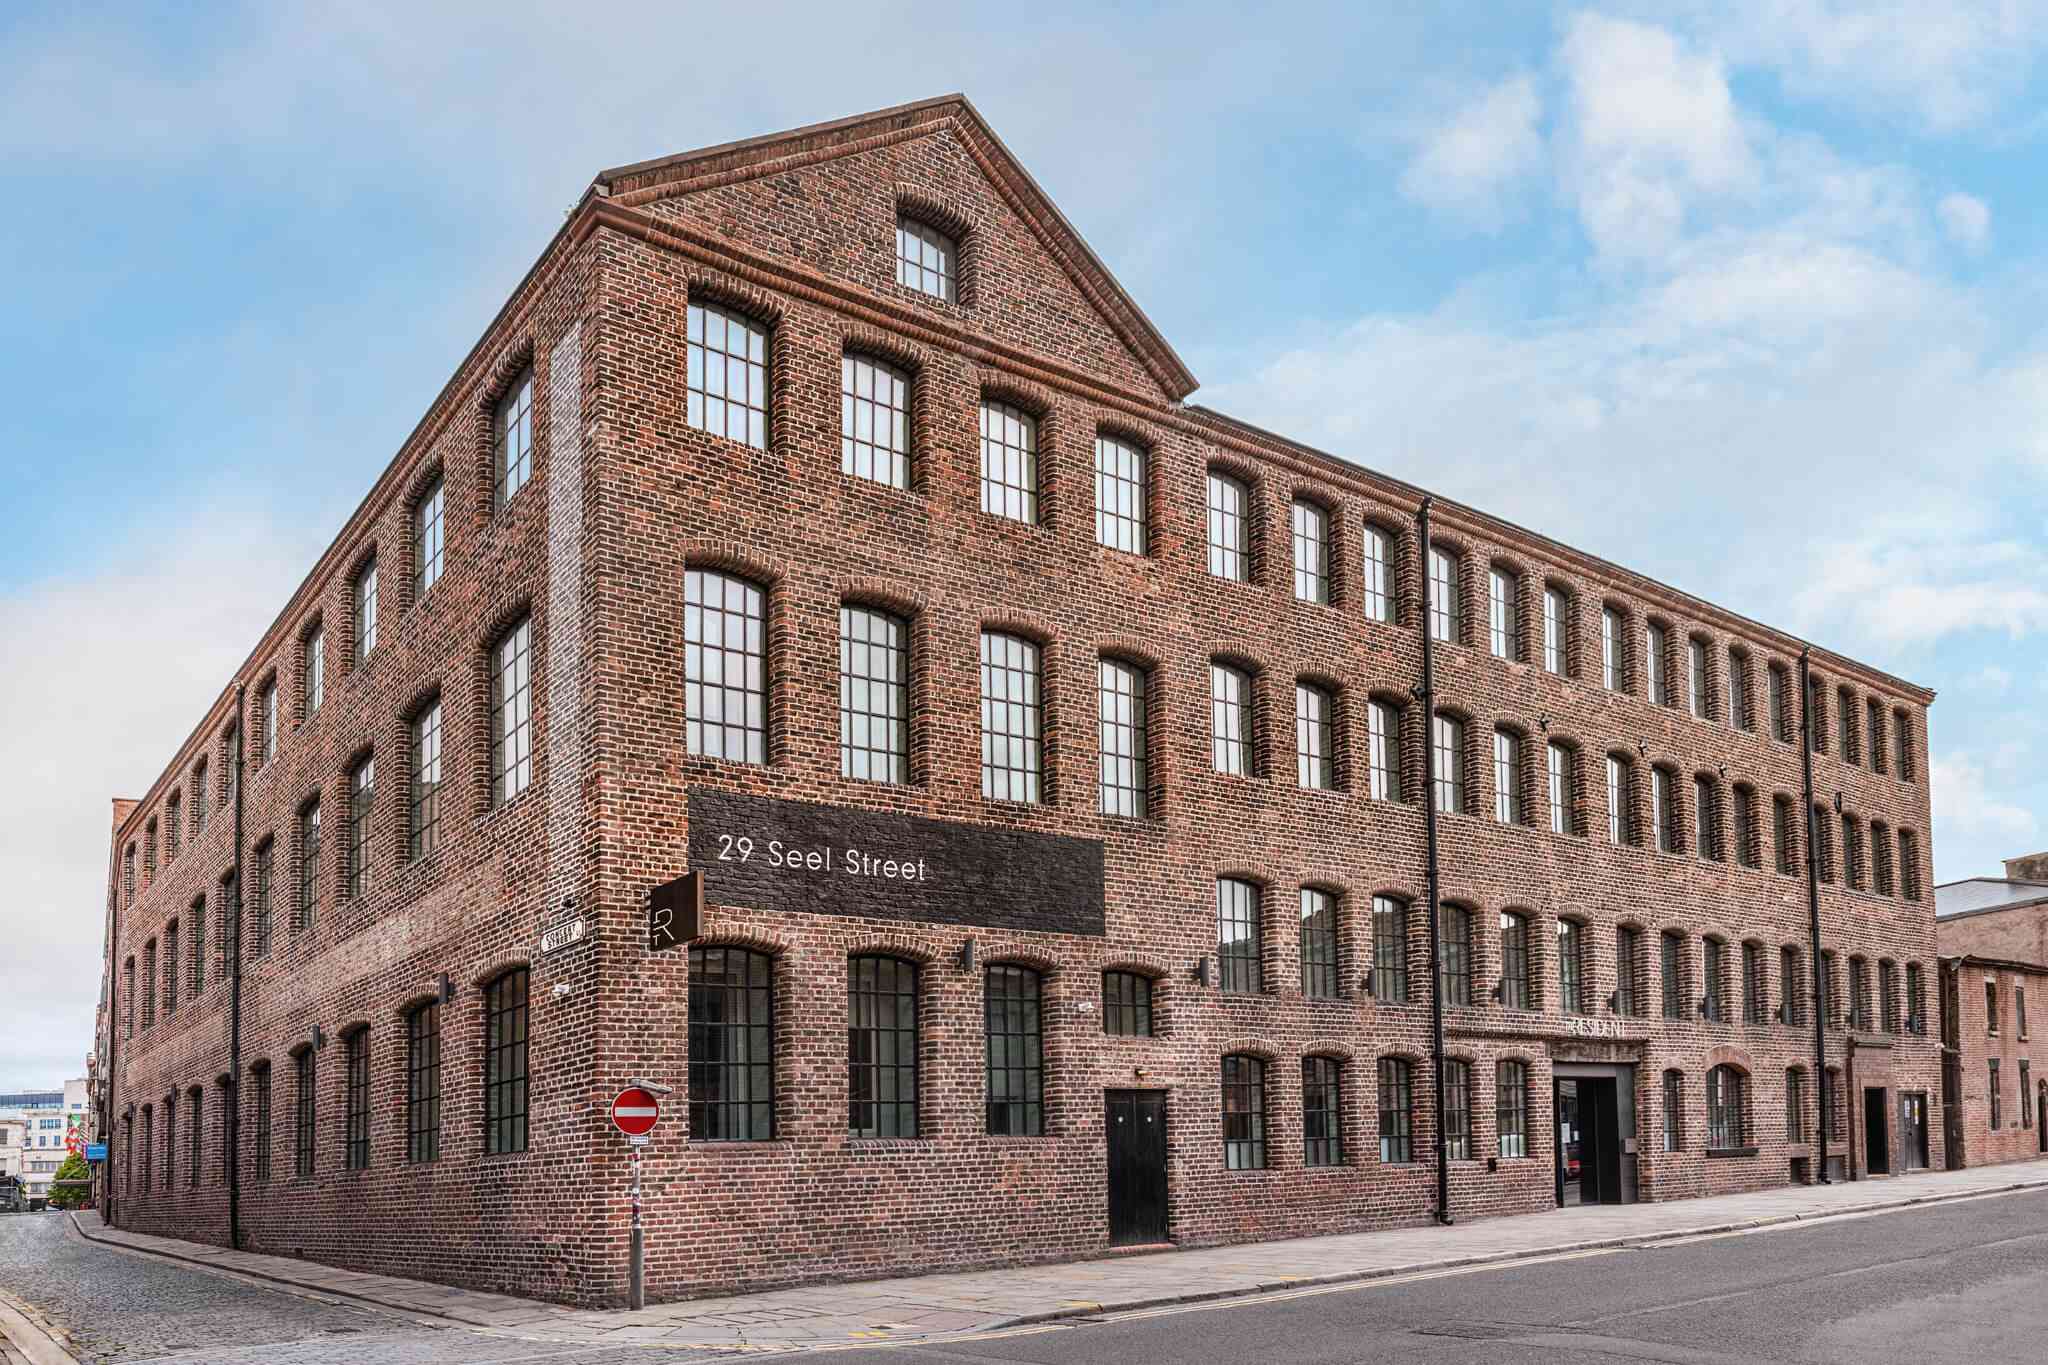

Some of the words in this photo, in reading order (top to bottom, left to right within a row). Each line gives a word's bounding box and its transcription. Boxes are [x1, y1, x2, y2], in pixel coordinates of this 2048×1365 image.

[718, 834, 753, 863] 29
[768, 841, 830, 871] Seel
[845, 850, 925, 881] Street
